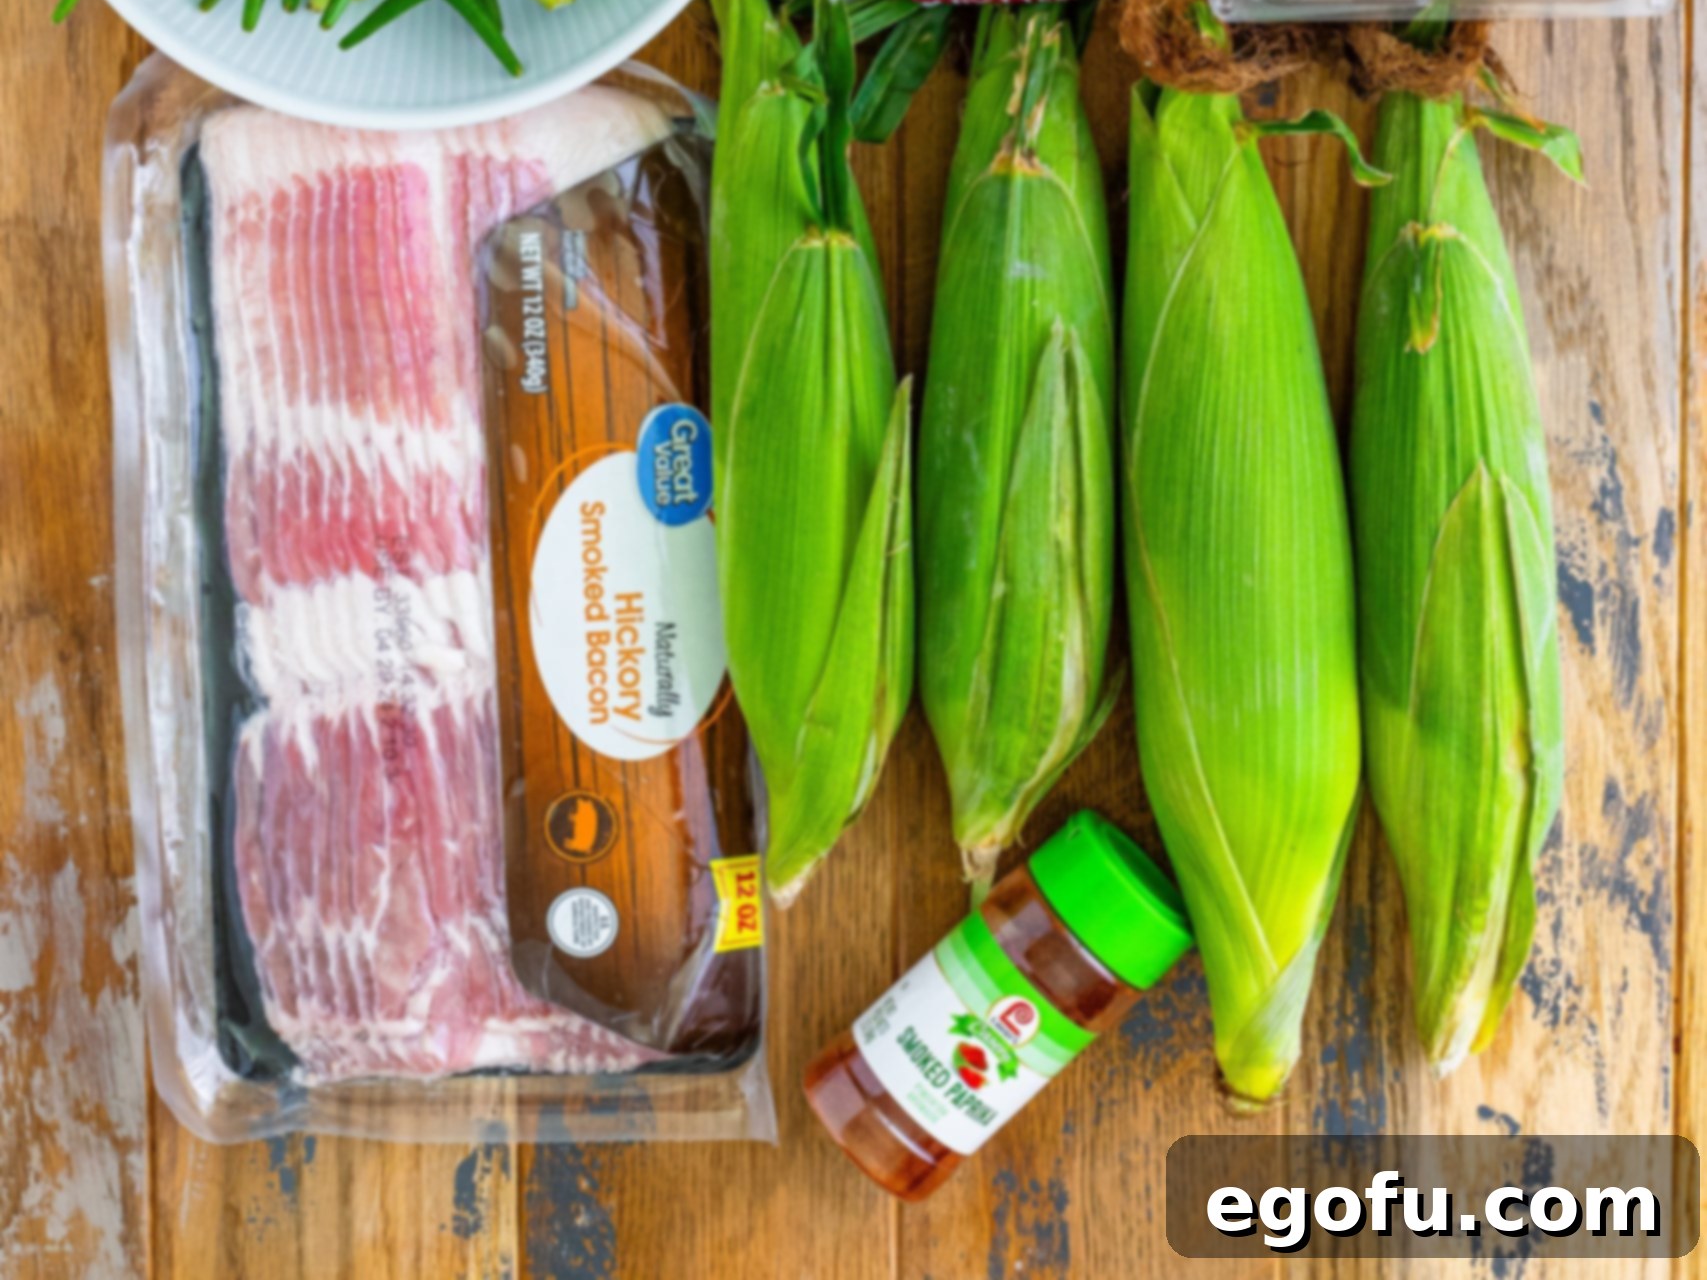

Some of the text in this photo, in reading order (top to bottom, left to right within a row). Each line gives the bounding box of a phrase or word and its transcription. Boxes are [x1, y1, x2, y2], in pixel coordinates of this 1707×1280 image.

[519, 232, 542, 262] NET
[521, 264, 543, 291] WT
[522, 295, 544, 315] 12
[523, 317, 546, 338] OZ
[654, 440, 673, 506] Value
[671, 419, 699, 504] Great
[580, 501, 611, 725] Smoked Bacon
[612, 592, 645, 722] Hickory
[647, 622, 681, 718] Naturally
[735, 870, 758, 934] 12 OZ
[896, 1025, 951, 1089] SMOKED
